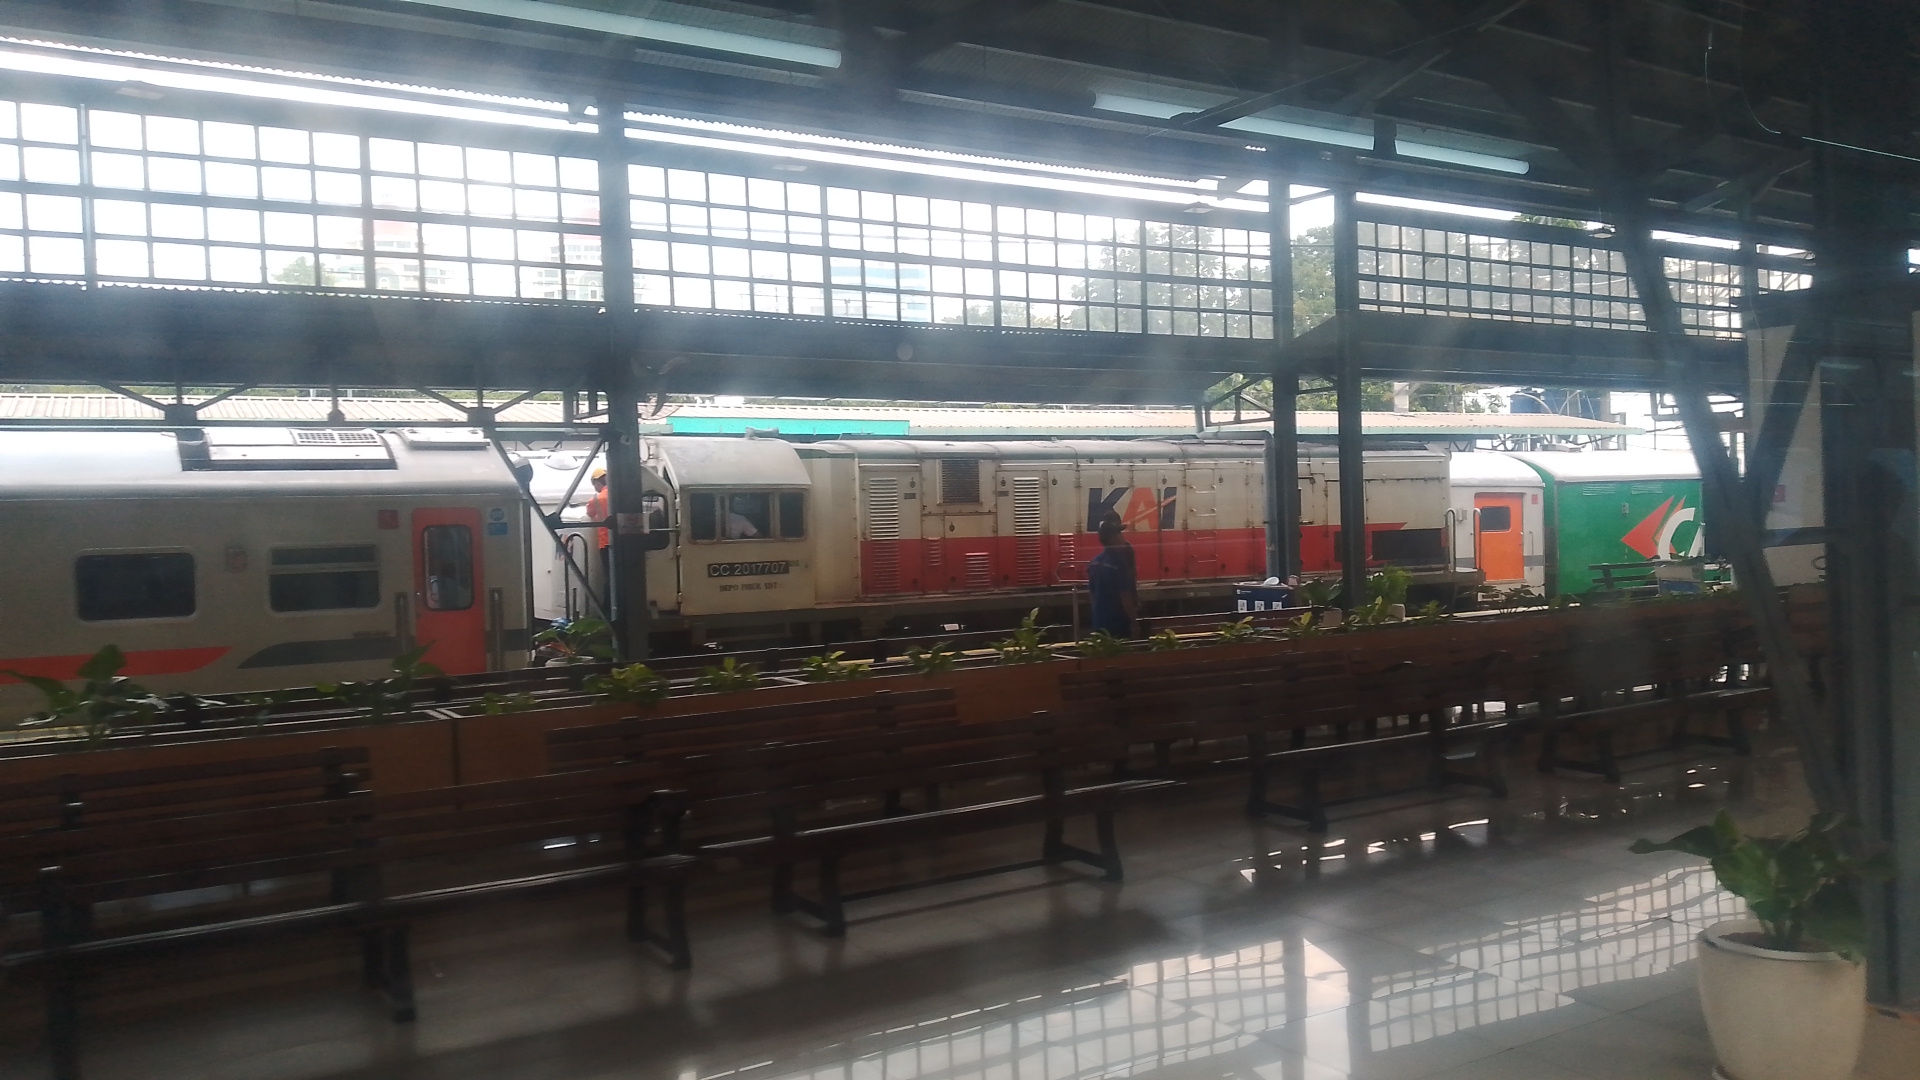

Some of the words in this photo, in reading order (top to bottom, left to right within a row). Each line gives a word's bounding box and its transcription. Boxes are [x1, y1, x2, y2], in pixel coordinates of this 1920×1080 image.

[1087, 487, 1177, 532] KAI
[709, 564, 730, 576] CC
[734, 562, 786, 575] 2017707
